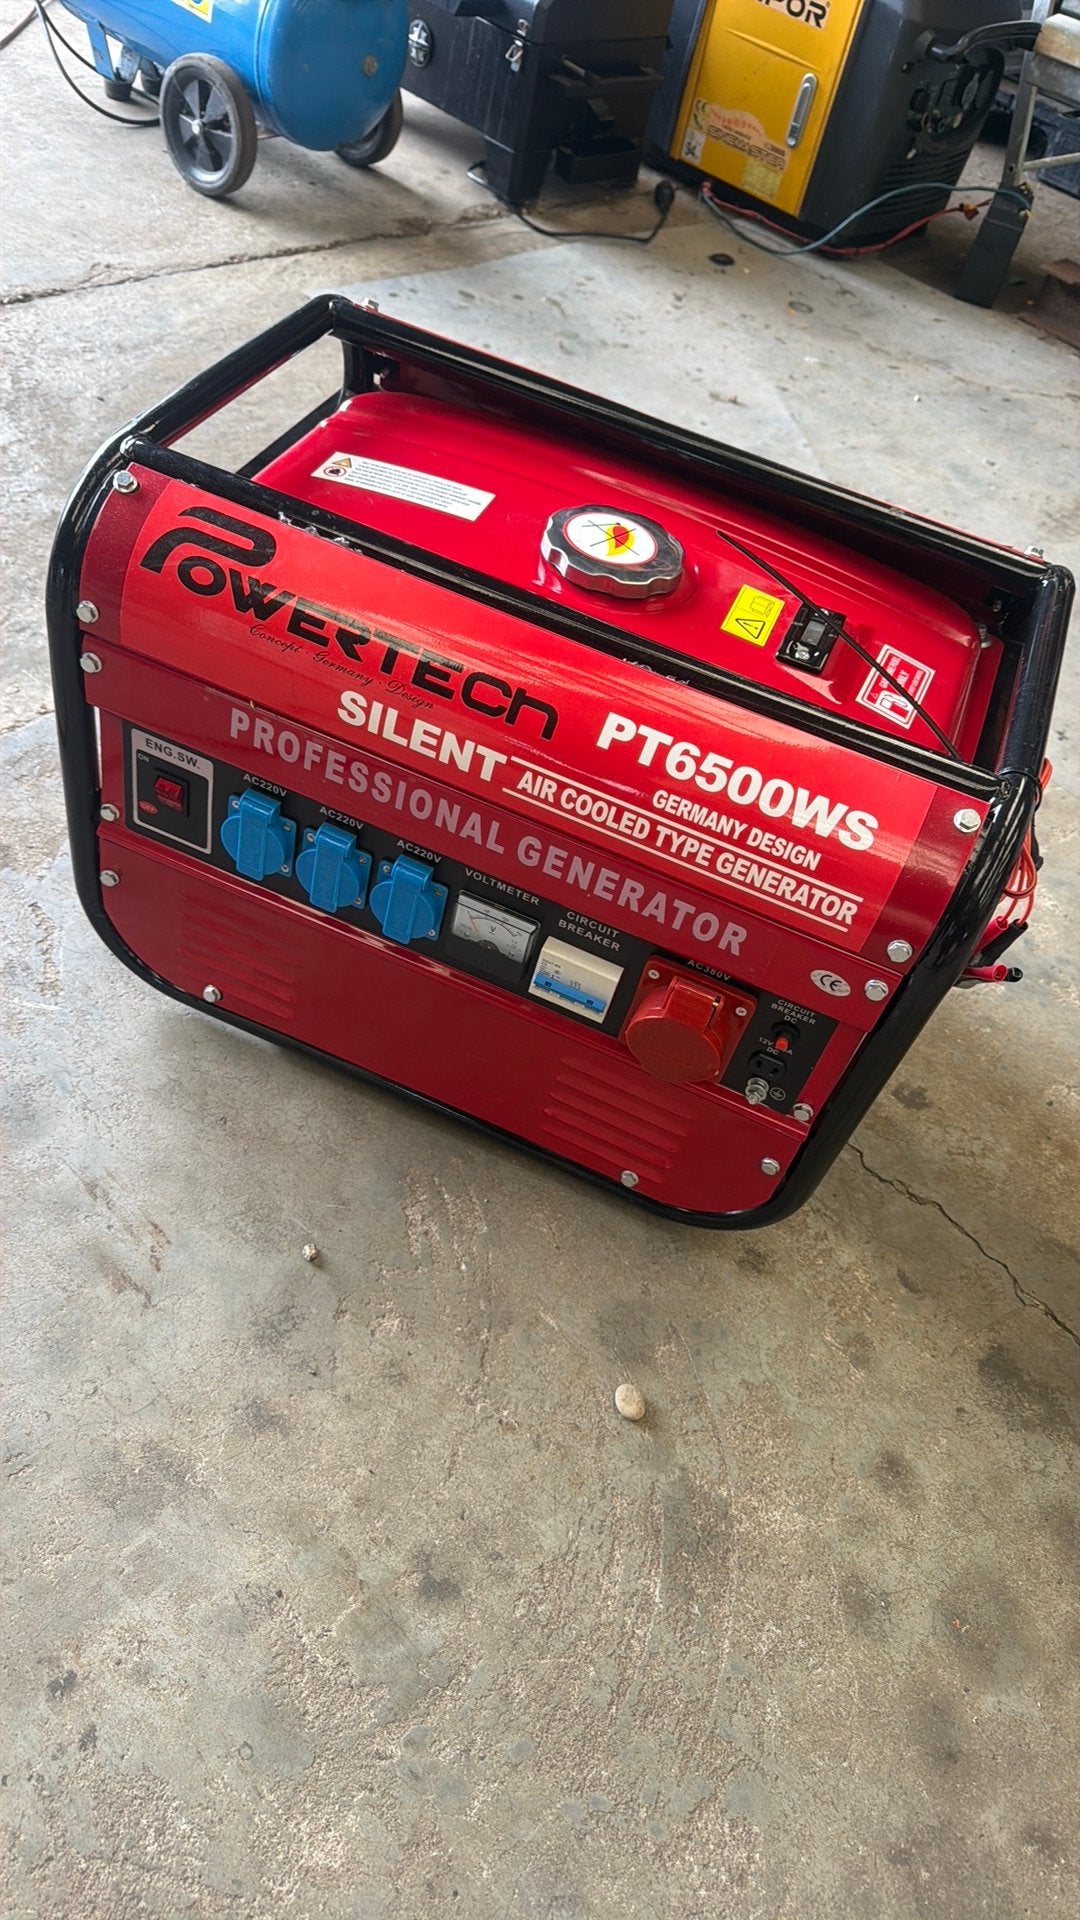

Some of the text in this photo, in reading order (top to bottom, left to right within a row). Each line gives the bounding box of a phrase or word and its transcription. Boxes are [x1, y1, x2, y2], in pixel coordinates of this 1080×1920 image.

[249, 623, 435, 710] Concept Germany Design
[337, 690, 507, 783] SILENT
[137, 752, 150, 763] ON
[242, 773, 287, 797] AC220V
[596, 712, 880, 852] PT6500WS
[319, 805, 364, 830] AC220V
[652, 789, 821, 871] GERMANY DESIGN
[230, 707, 747, 957] PROFESSIONAL GENERATOR
[396, 839, 442, 863] AC220V
[516, 771, 859, 926] AIR COOLED TYPE GENERATOR
[464, 868, 540, 906] VOLTMETER
[558, 919, 620, 951] BREAKER
[566, 911, 619, 938] CIRCUIT
[687, 959, 732, 981] AC380V
[770, 1003, 816, 1025] BREAKER
[777, 999, 816, 1018] CIRCUIT
[783, 1014, 798, 1025] DC
[766, 1046, 779, 1055] DC
